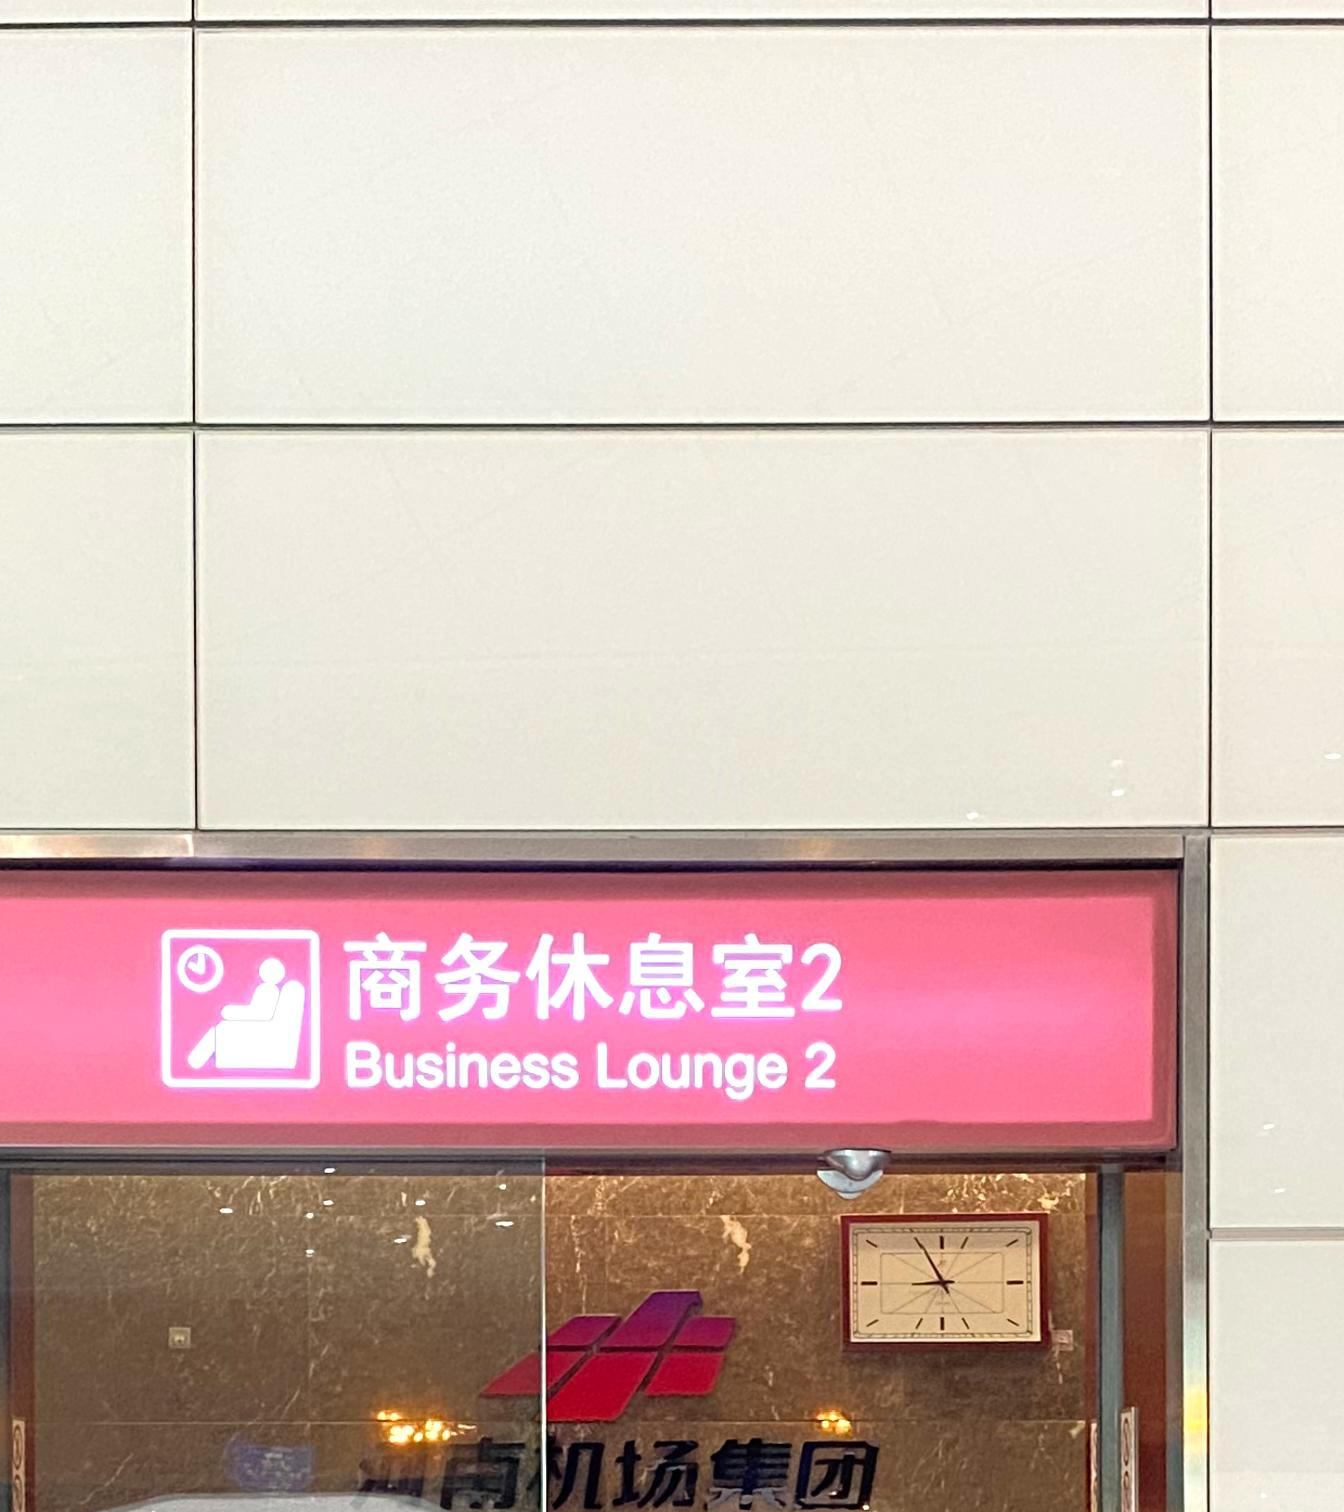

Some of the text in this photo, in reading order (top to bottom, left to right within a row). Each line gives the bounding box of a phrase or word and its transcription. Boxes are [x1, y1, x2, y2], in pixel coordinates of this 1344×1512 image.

[342, 930, 845, 1021] 商务休息室2
[345, 1041, 838, 1101] Business Lounge 2
